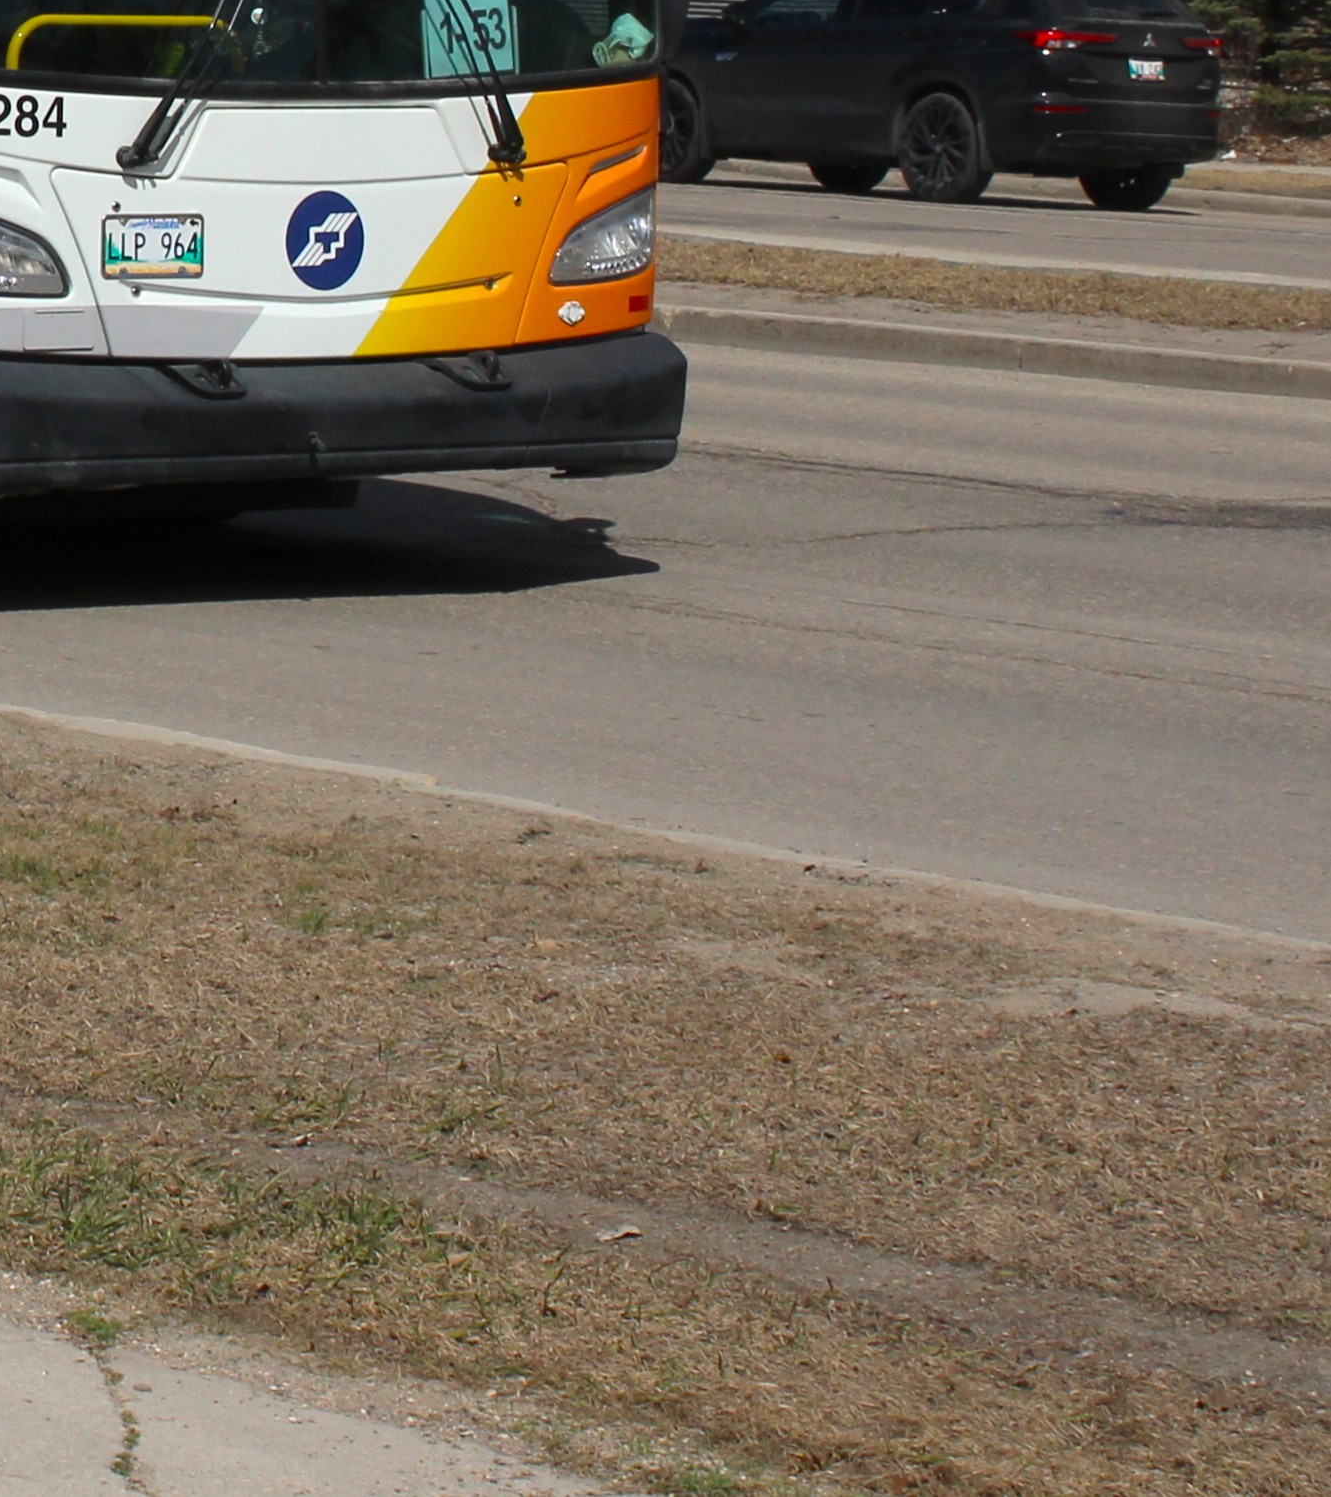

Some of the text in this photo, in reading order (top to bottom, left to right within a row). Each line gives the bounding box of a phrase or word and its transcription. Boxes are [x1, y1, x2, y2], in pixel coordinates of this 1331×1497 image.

[439, 7, 506, 55] 1-53
[108, 231, 199, 262] LLP 964
